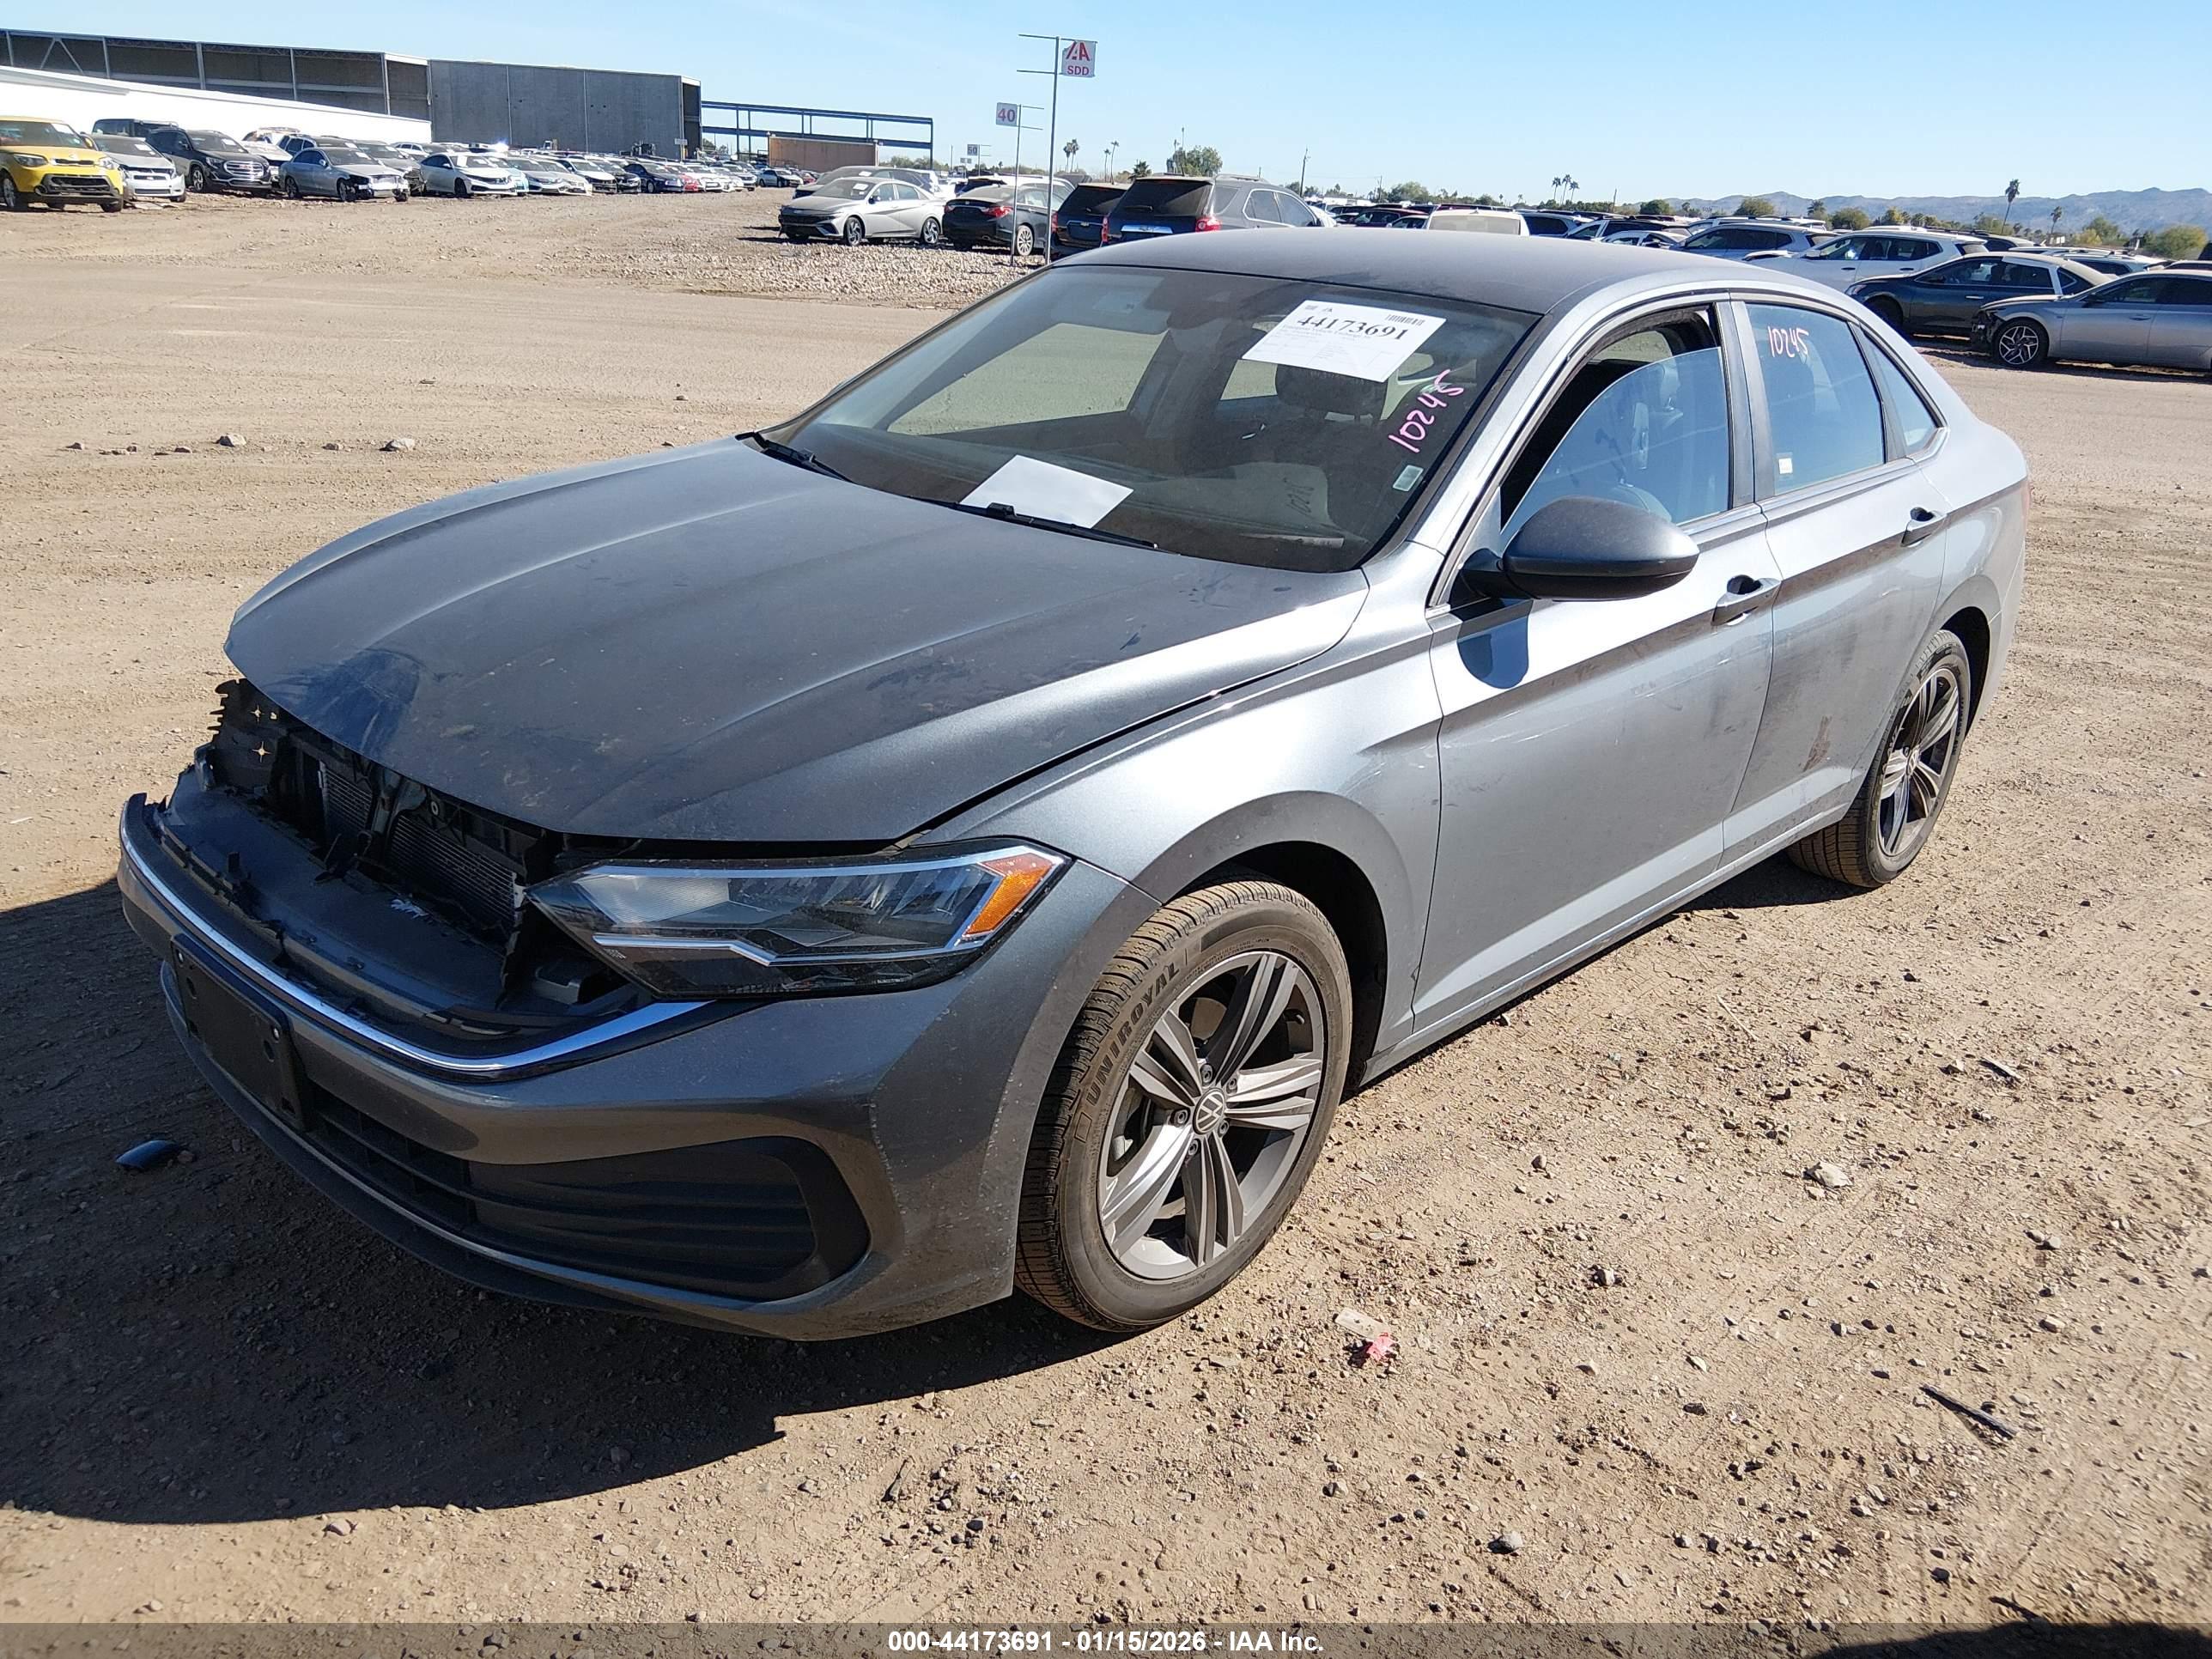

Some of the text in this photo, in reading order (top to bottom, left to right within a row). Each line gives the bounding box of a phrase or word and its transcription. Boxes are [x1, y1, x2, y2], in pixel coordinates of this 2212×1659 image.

[1066, 65, 1090, 76] SDD
[997, 107, 1016, 123] 40
[1297, 315, 1409, 340] 44173691
[1767, 325, 1809, 359] 10245
[1086, 962, 1181, 1107] UNIROYAL
